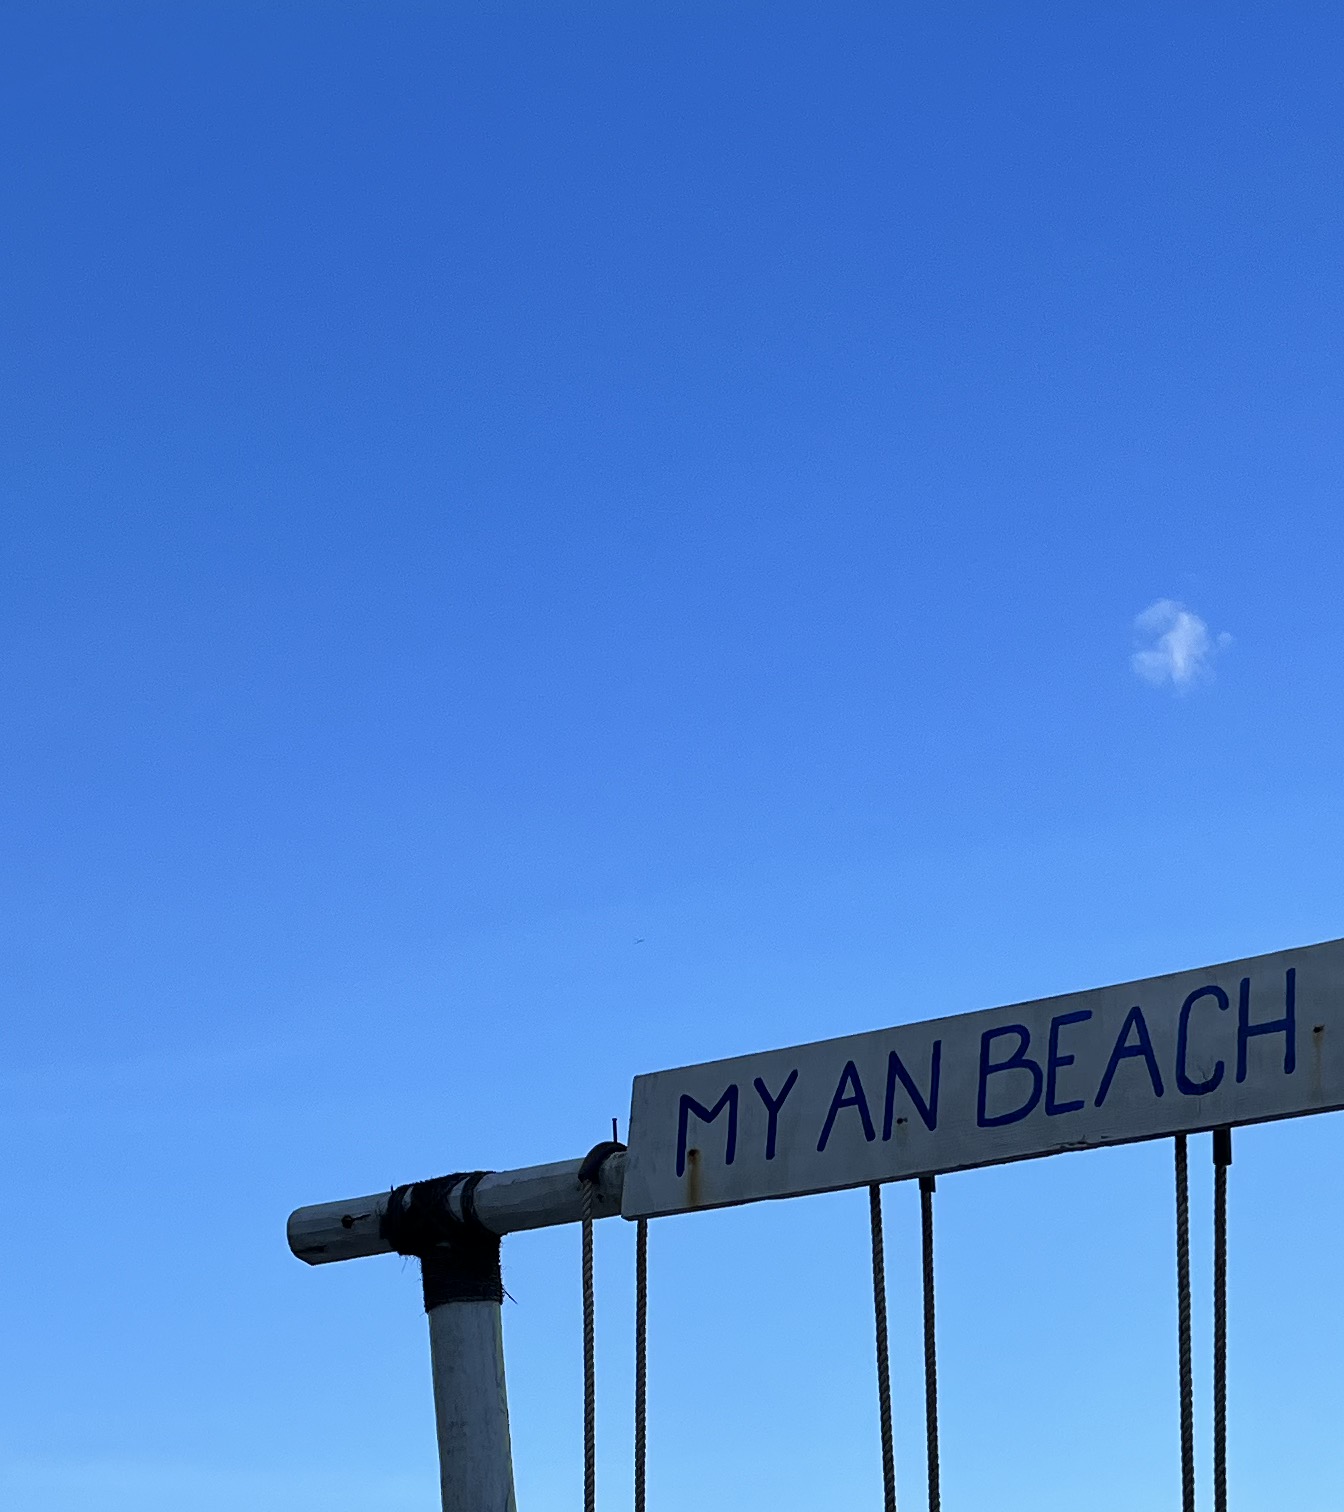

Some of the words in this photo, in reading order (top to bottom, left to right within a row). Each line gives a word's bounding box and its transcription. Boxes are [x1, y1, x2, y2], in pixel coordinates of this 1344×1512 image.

[676, 1068, 799, 1178] MY
[817, 1039, 942, 1152] AN
[976, 967, 1297, 1128] BEACH
